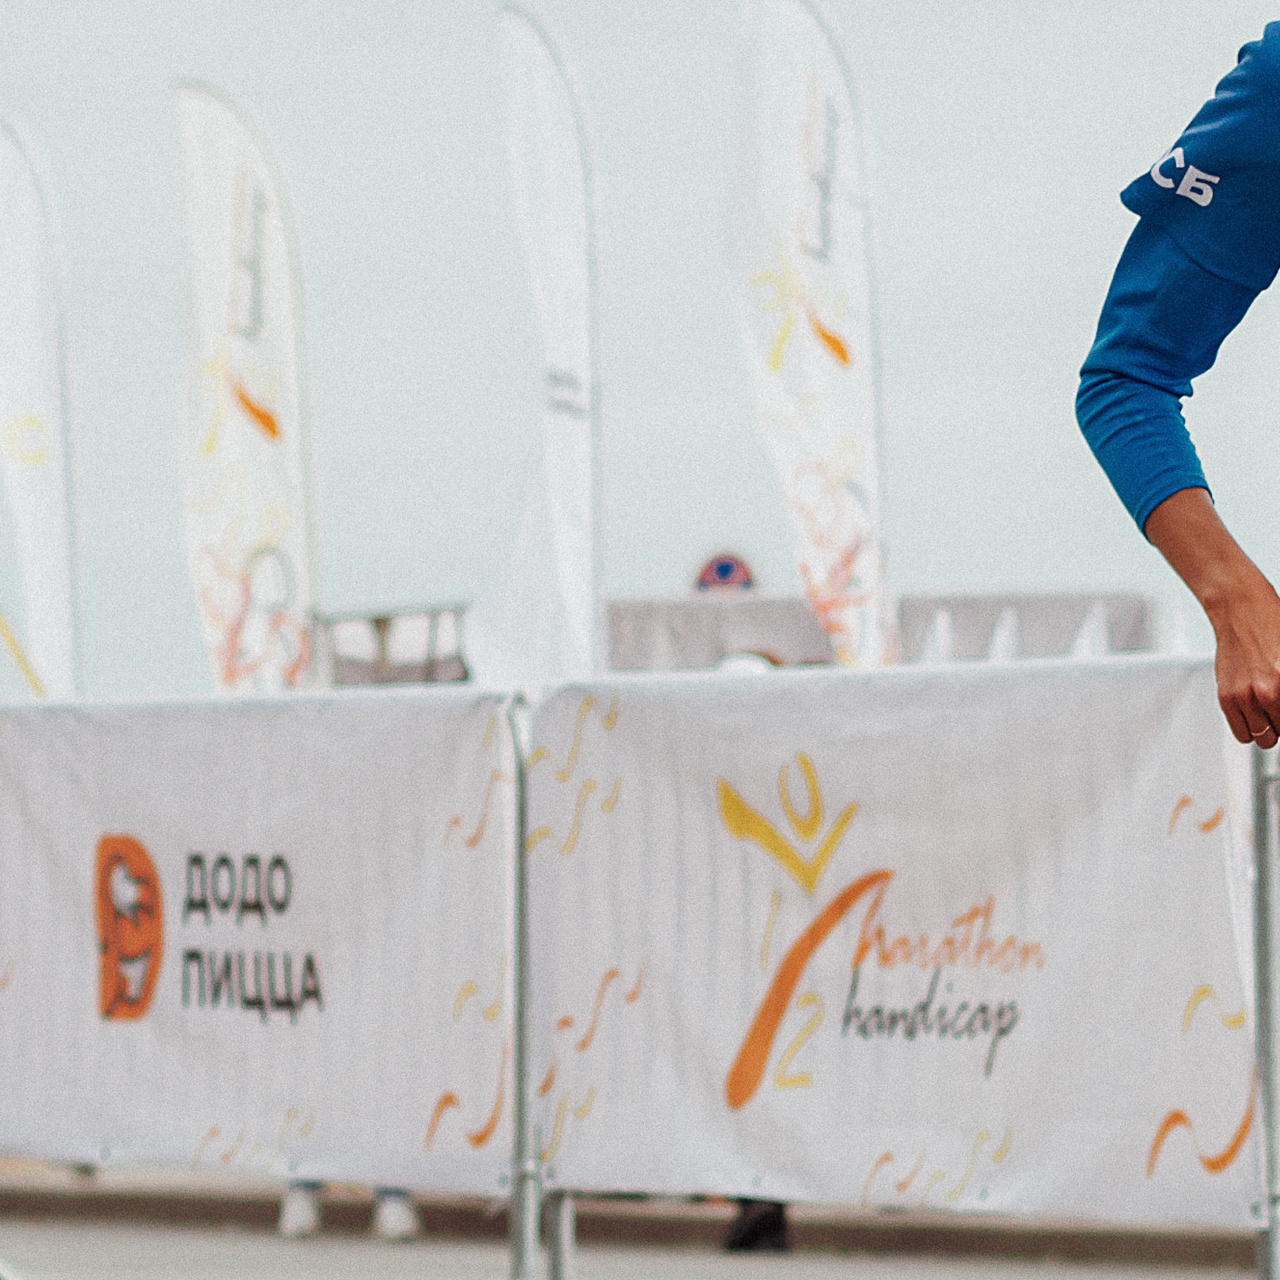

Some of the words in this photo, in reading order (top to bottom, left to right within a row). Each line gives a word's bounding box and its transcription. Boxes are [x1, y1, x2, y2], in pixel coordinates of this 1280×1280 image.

[182, 851, 293, 927] ДОДО
[181, 948, 326, 1025] ПИЦЦА
[841, 966, 1021, 1081] handicap
